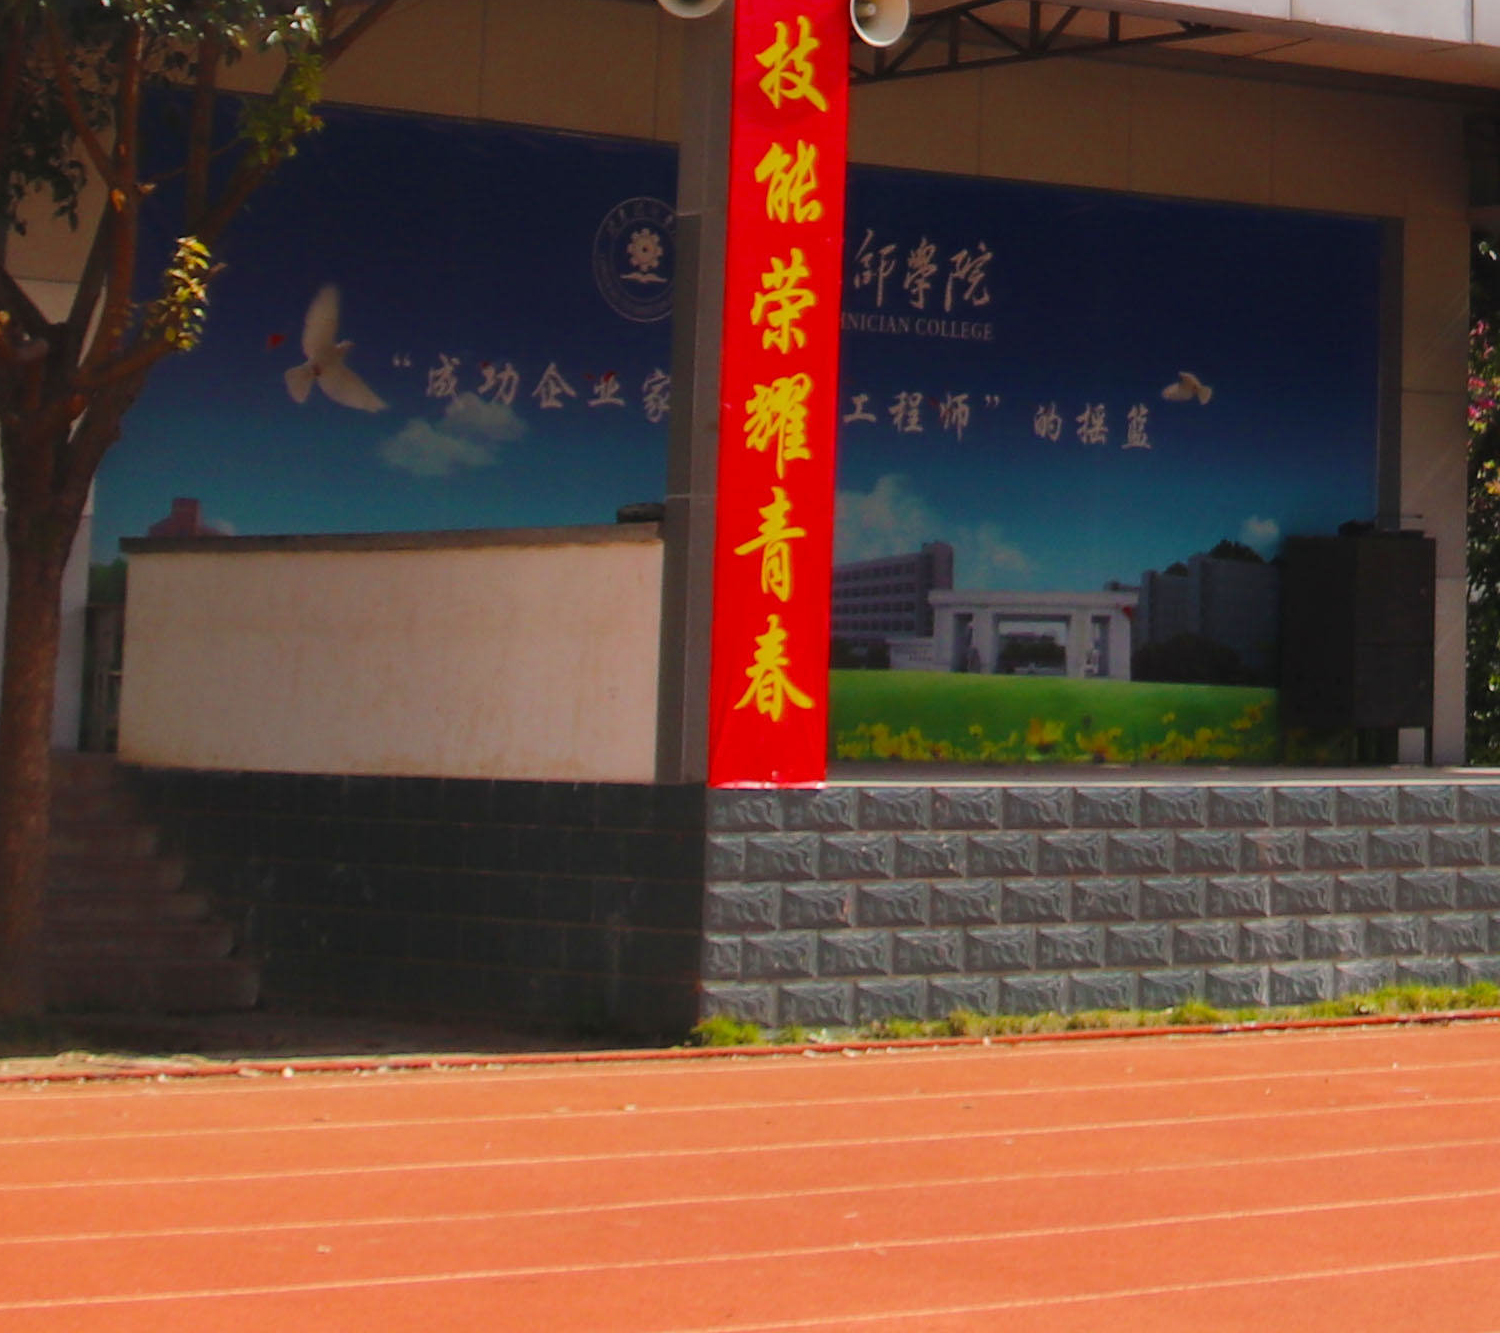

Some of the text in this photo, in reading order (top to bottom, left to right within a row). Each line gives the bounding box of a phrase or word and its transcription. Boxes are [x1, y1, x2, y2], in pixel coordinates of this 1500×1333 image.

[734, 14, 830, 724] 技能荣耀青春
[914, 317, 994, 341] COLLEGE
